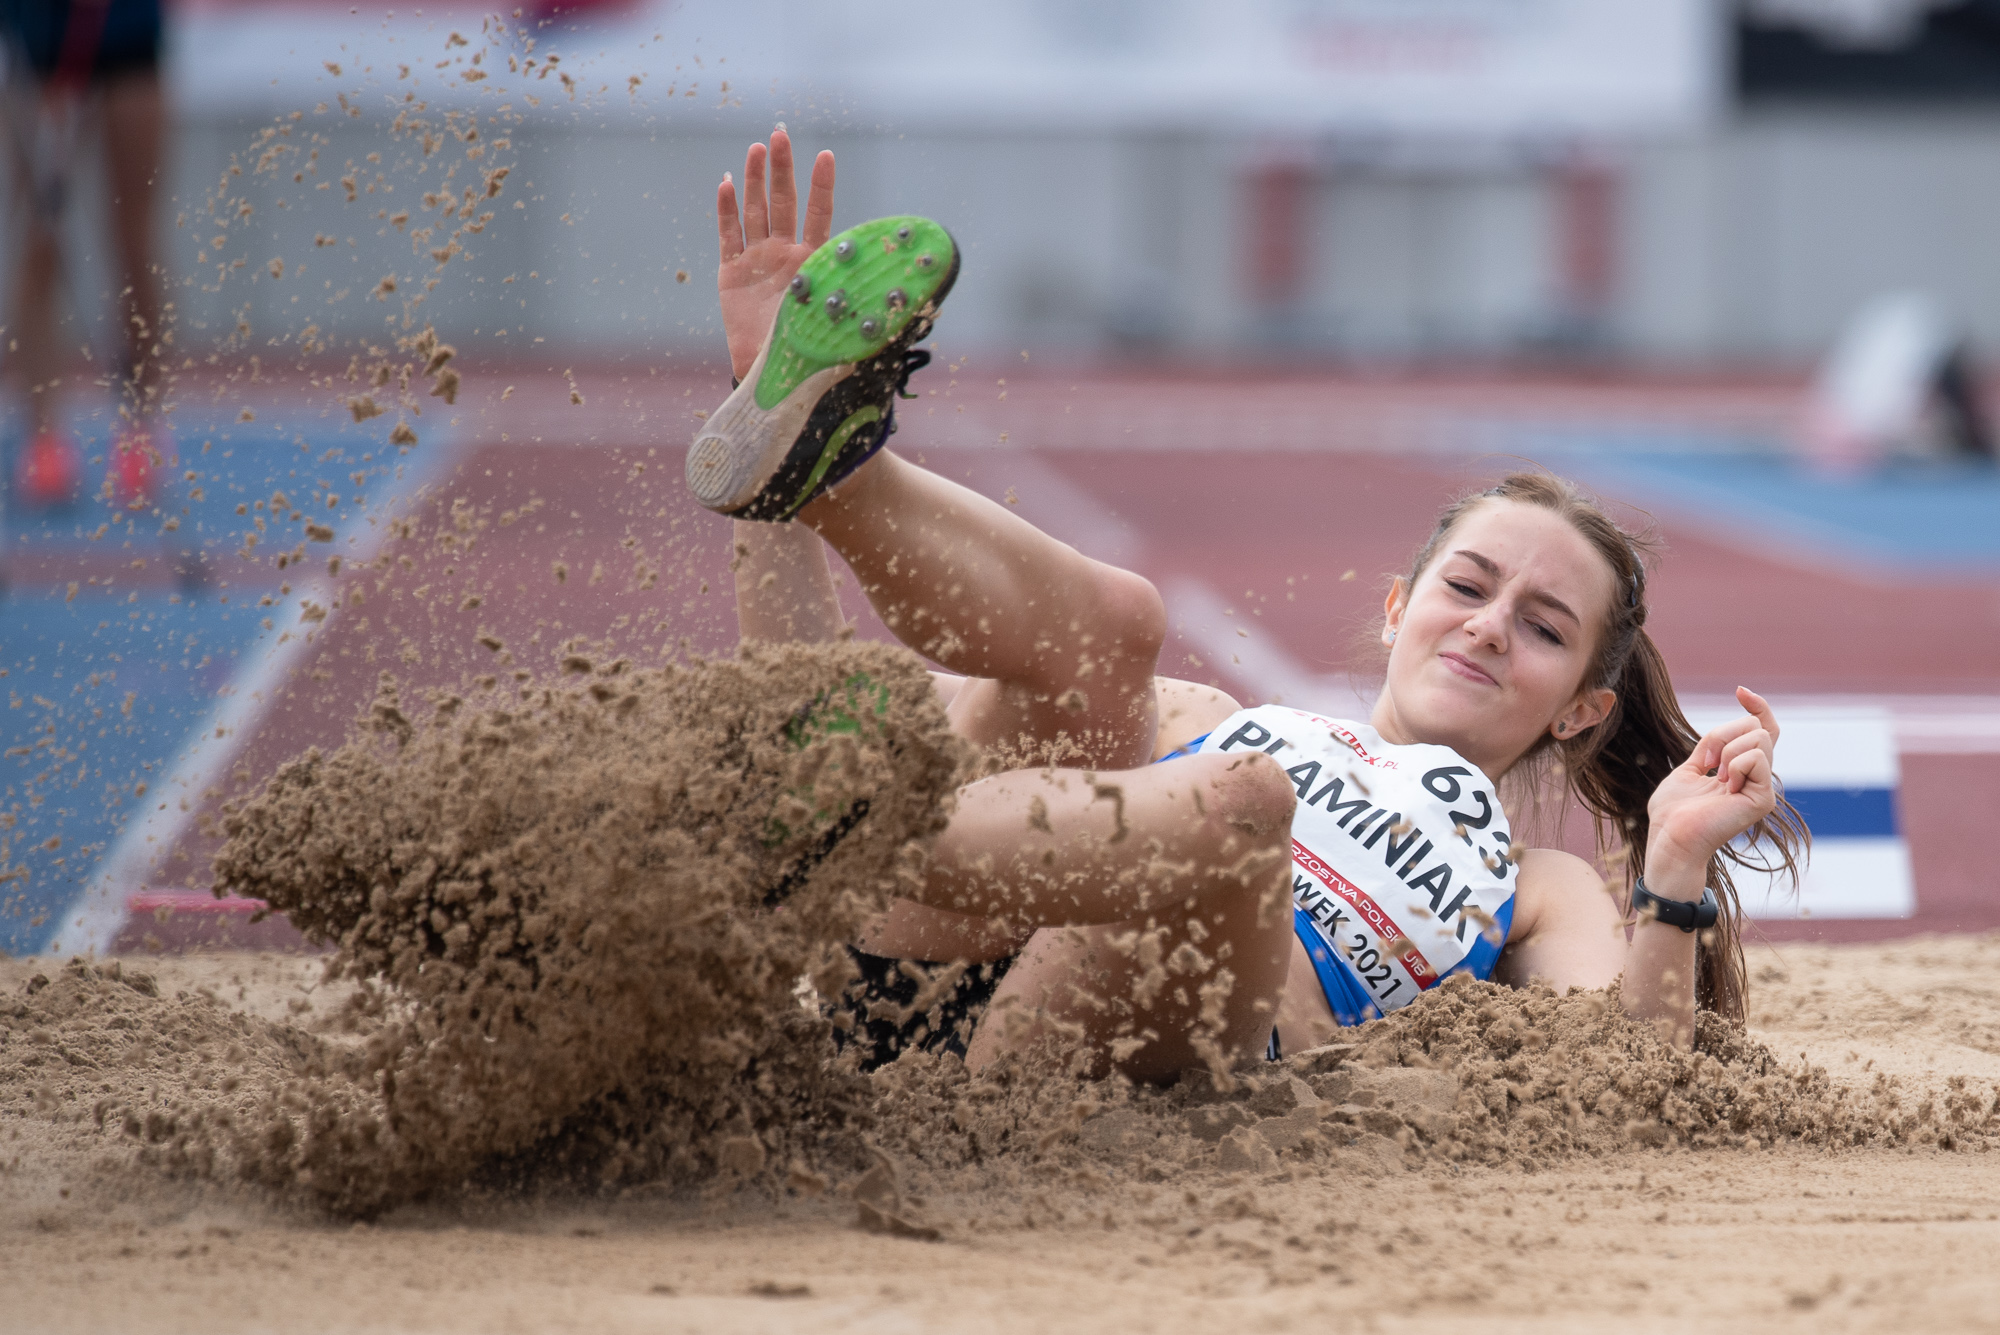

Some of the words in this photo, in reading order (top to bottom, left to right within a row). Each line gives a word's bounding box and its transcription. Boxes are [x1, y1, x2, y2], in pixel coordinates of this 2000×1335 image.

[1421, 766, 1514, 880] 623
[1292, 874, 1352, 938] WEK
[1347, 933, 1403, 1001] 2021
[1358, 899, 1402, 945] POLSK
[1403, 951, 1427, 978] U18
